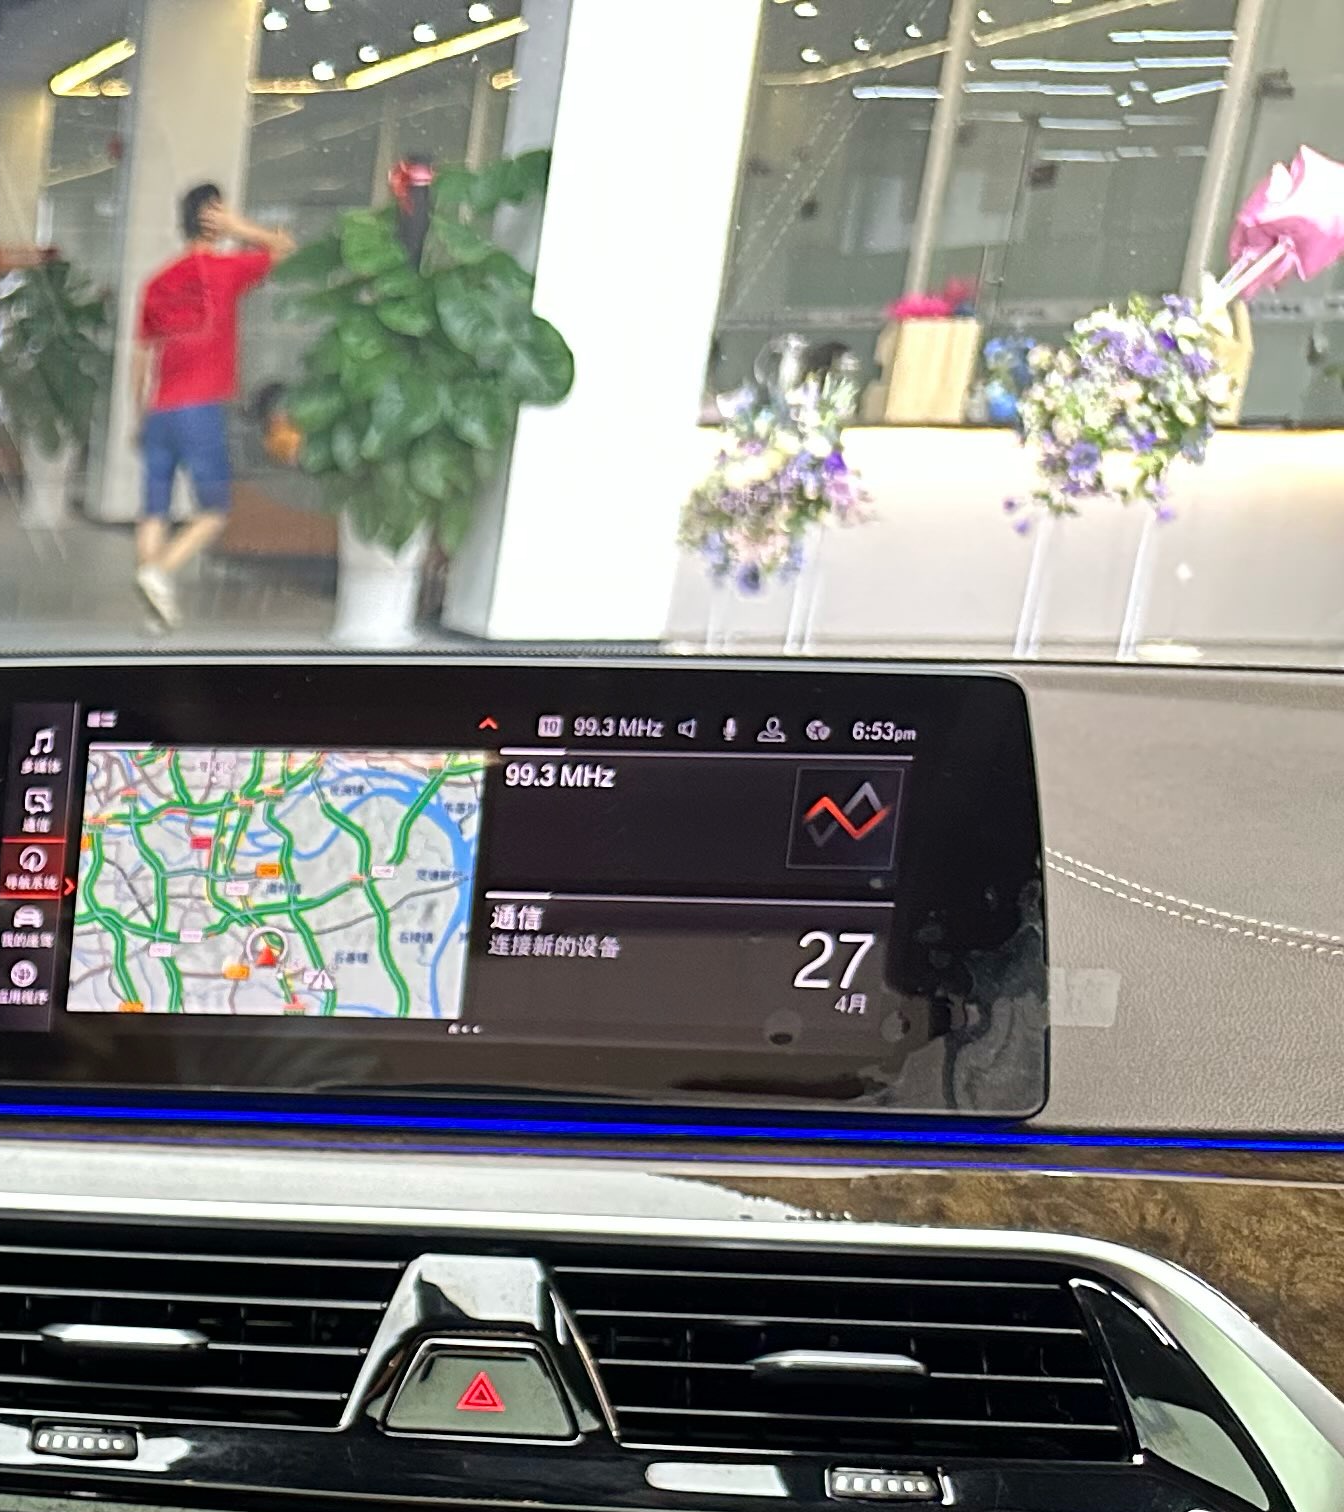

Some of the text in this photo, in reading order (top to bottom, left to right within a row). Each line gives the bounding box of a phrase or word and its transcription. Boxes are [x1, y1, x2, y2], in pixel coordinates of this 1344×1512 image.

[574, 717, 665, 739] 99.3 MHz
[852, 721, 917, 743] 6:53pm
[505, 765, 616, 788] 99.3 MHz
[490, 905, 544, 931] 通信
[487, 934, 622, 959] 连接新的设备
[793, 931, 875, 990] 27
[834, 994, 868, 1015] 4月
